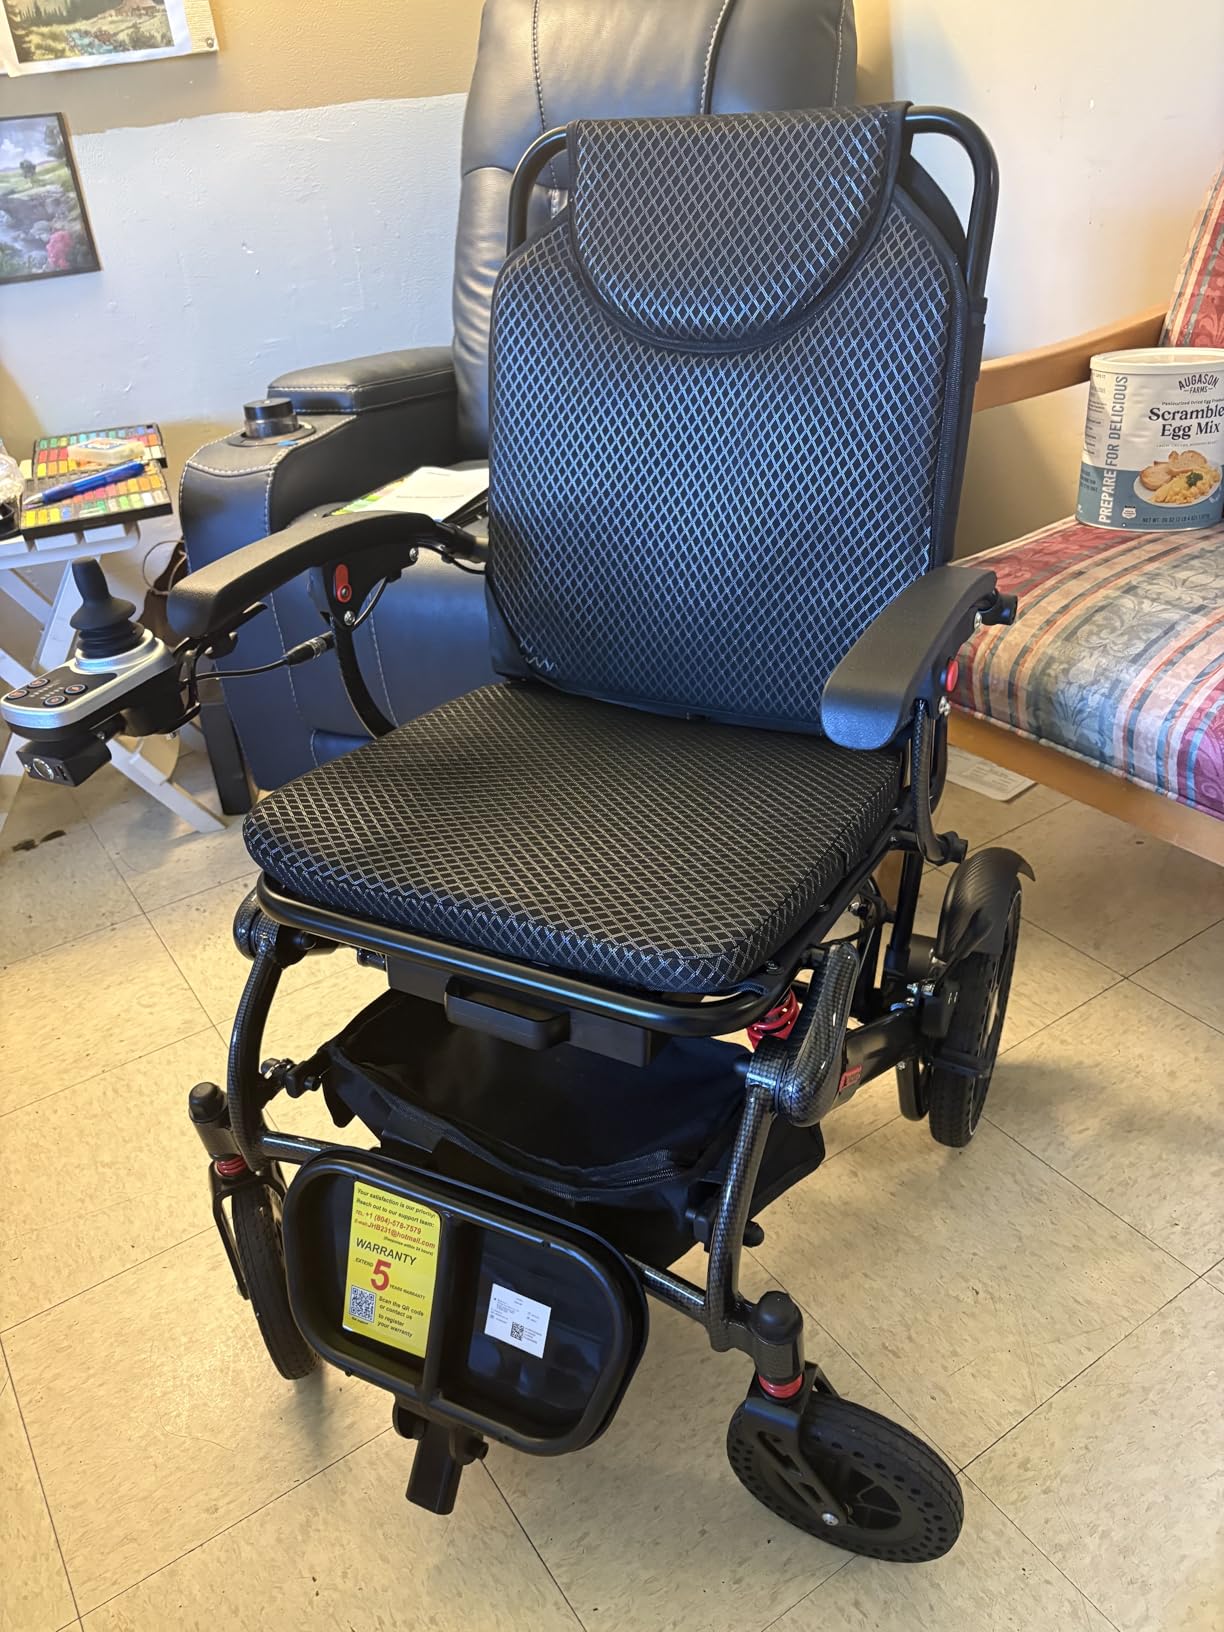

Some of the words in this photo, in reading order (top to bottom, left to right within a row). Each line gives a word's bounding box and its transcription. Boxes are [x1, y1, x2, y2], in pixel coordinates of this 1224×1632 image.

[1178, 373, 1220, 391] AUGASON
[1189, 386, 1208, 394] FARMS
[1108, 376, 1128, 440] DELICIOUS
[1160, 423, 1193, 440] Egg
[1195, 420, 1221, 435] Mix
[1105, 444, 1120, 467] FOR
[1098, 470, 1117, 523] PREPARE
[357, 1188, 369, 1196] Your
[370, 1193, 399, 1206] satisfaction
[356, 1198, 372, 1207] Reach
[398, 1213, 419, 1223] support
[356, 1237, 417, 1265] WARRANTY
[355, 1257, 374, 1268] EXTEND
[370, 1258, 392, 1291] 5
[389, 1283, 403, 1292] YEARS
[403, 1288, 425, 1301] WARRANTY
[378, 1295, 392, 1305] Scan
[392, 1300, 401, 1308] the
[401, 1304, 410, 1312] QR
[411, 1308, 424, 1317] code
[386, 1307, 405, 1317] contact
[377, 1321, 390, 1329] your
[390, 1325, 413, 1338] warranty
[384, 1315, 405, 1327] register
